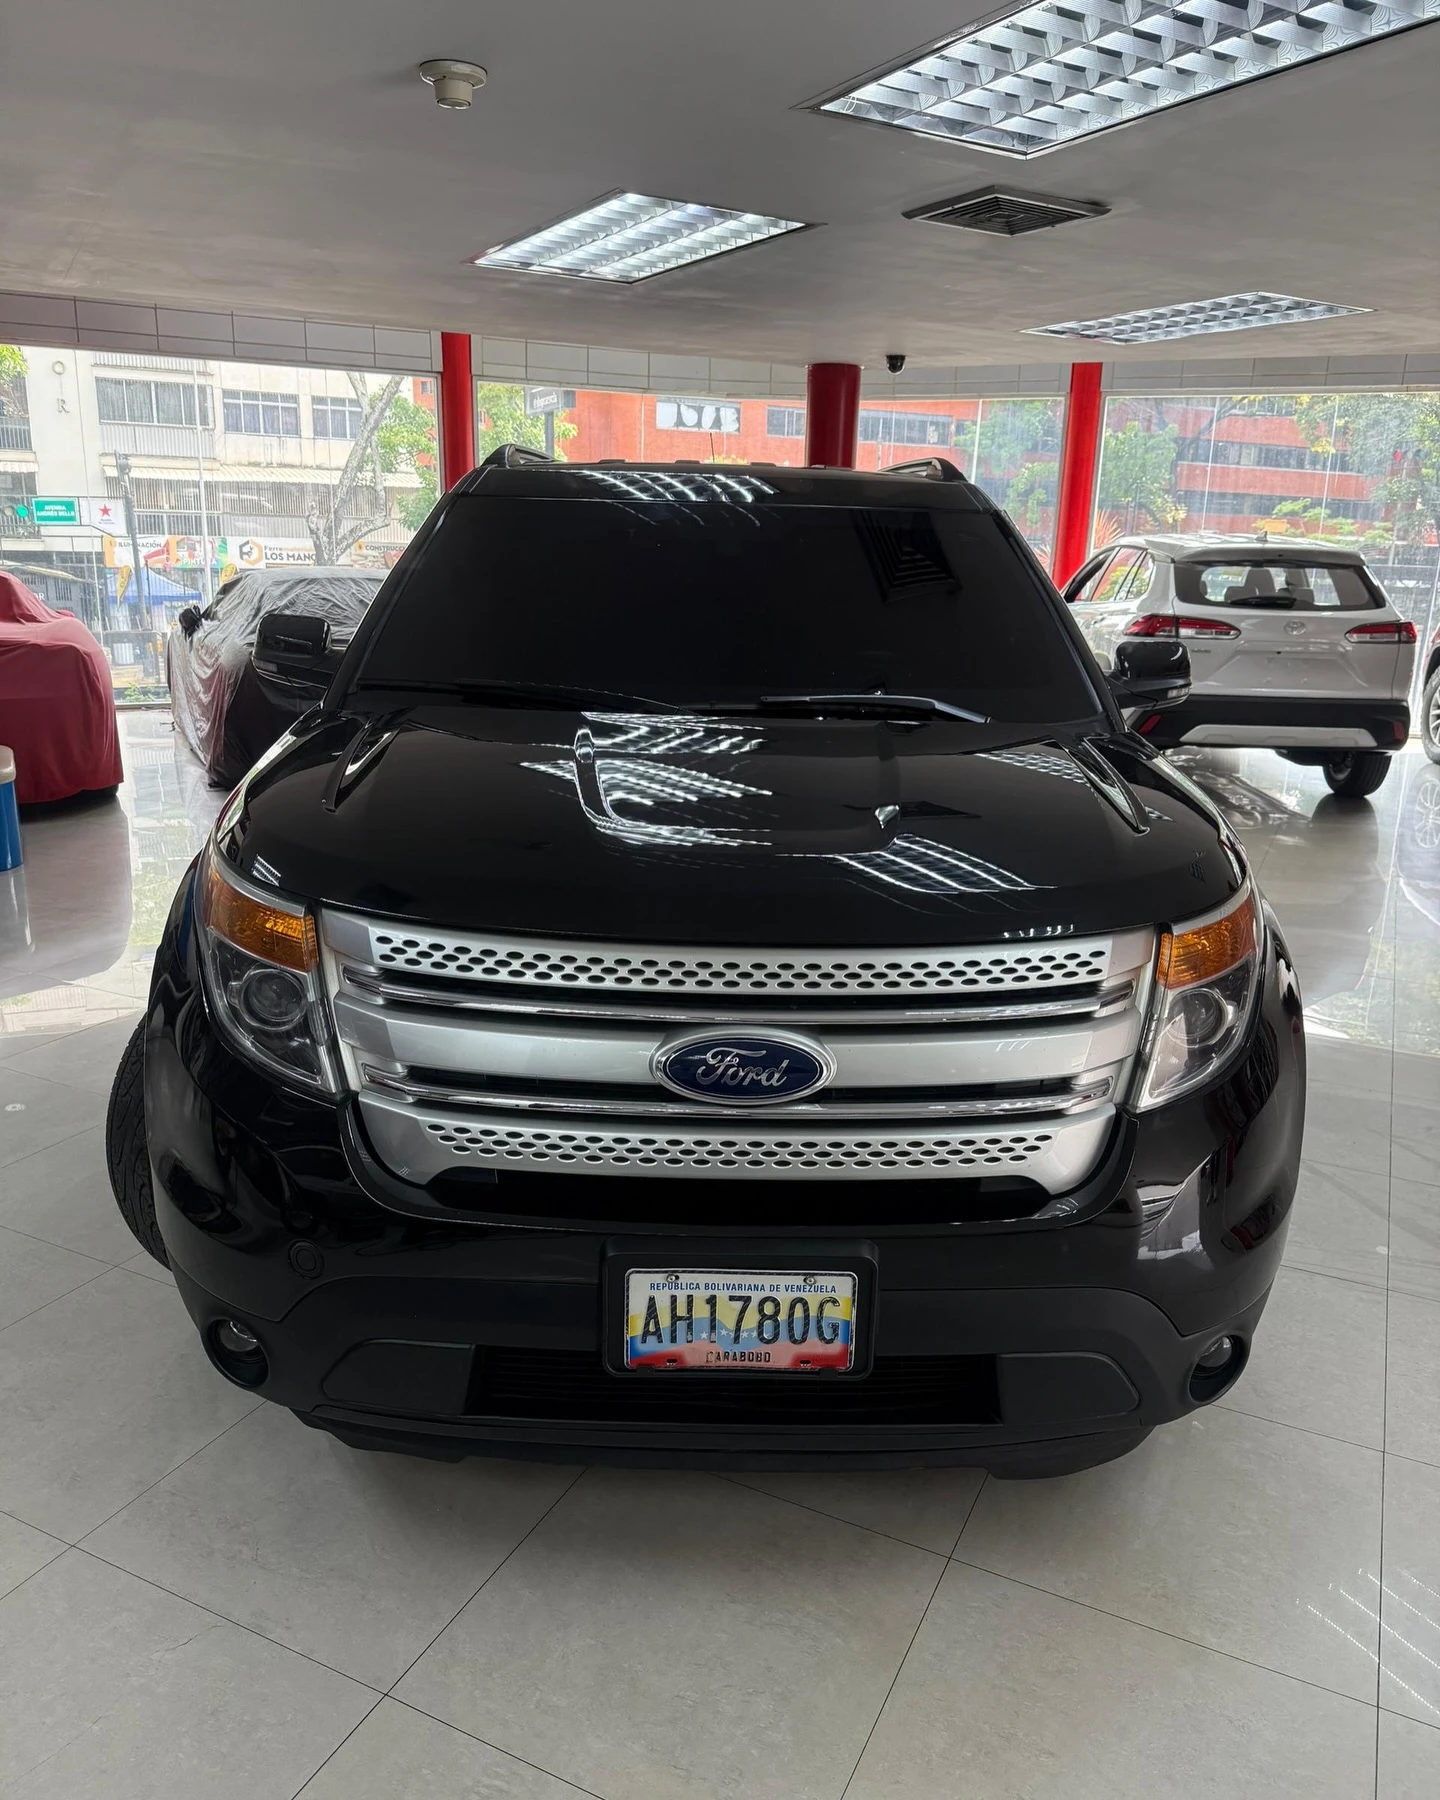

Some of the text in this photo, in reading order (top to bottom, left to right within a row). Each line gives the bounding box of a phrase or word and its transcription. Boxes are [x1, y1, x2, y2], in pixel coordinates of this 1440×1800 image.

[264, 552, 284, 561] LOS
[696, 1047, 790, 1087] Ford
[704, 1282, 766, 1293] BOLIVARIANA
[769, 1284, 781, 1293] DE
[784, 1284, 837, 1294] VENEZUELA
[640, 1294, 841, 1346] AH1780G
[705, 1350, 771, 1363] CARABOBO
